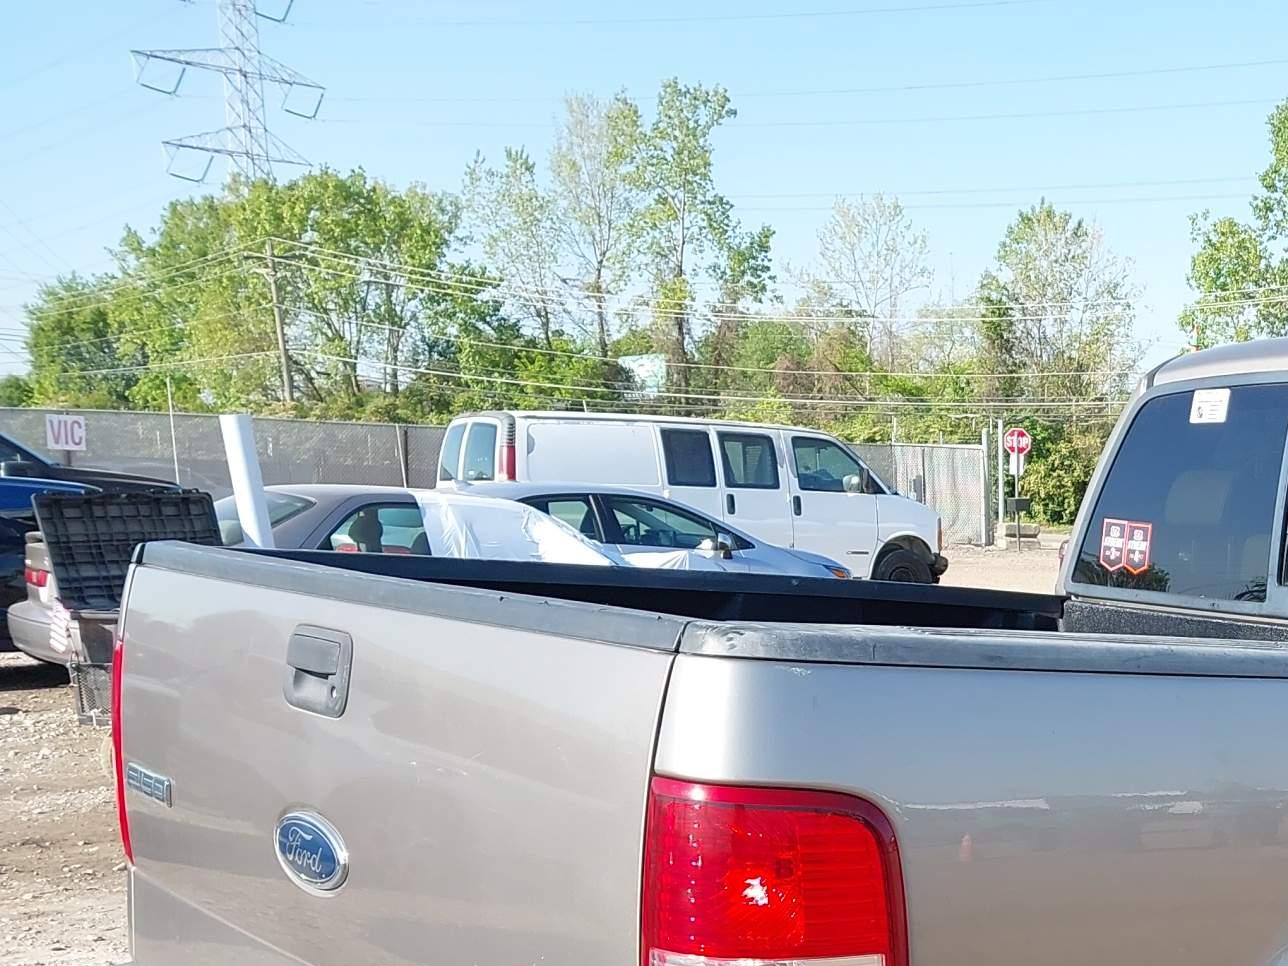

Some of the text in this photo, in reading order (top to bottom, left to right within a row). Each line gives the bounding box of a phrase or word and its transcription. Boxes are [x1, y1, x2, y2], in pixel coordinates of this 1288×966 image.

[48, 419, 82, 446] VIC
[1006, 435, 1029, 449] STOP
[286, 826, 323, 873] Ford
